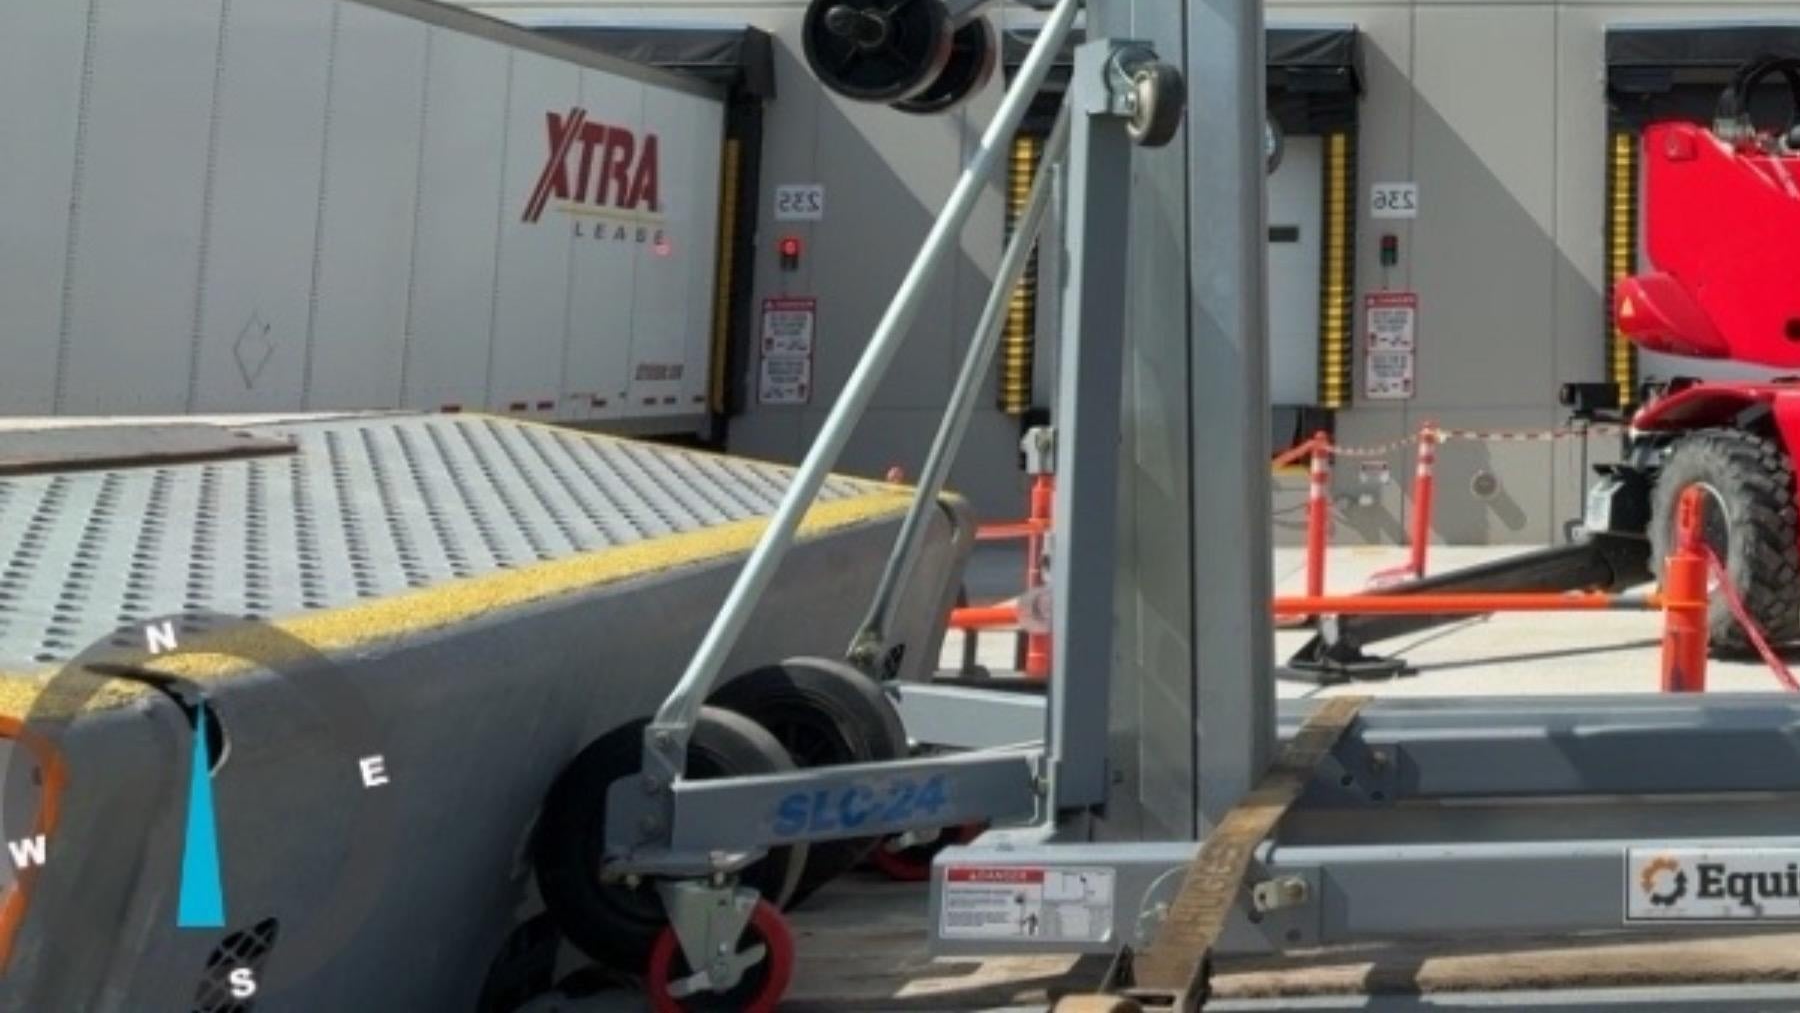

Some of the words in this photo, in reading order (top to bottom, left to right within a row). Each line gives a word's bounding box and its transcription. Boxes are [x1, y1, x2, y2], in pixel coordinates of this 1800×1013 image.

[522, 106, 659, 223] XTRA
[575, 221, 664, 245] LEASE
[773, 774, 947, 835] SLC-24
